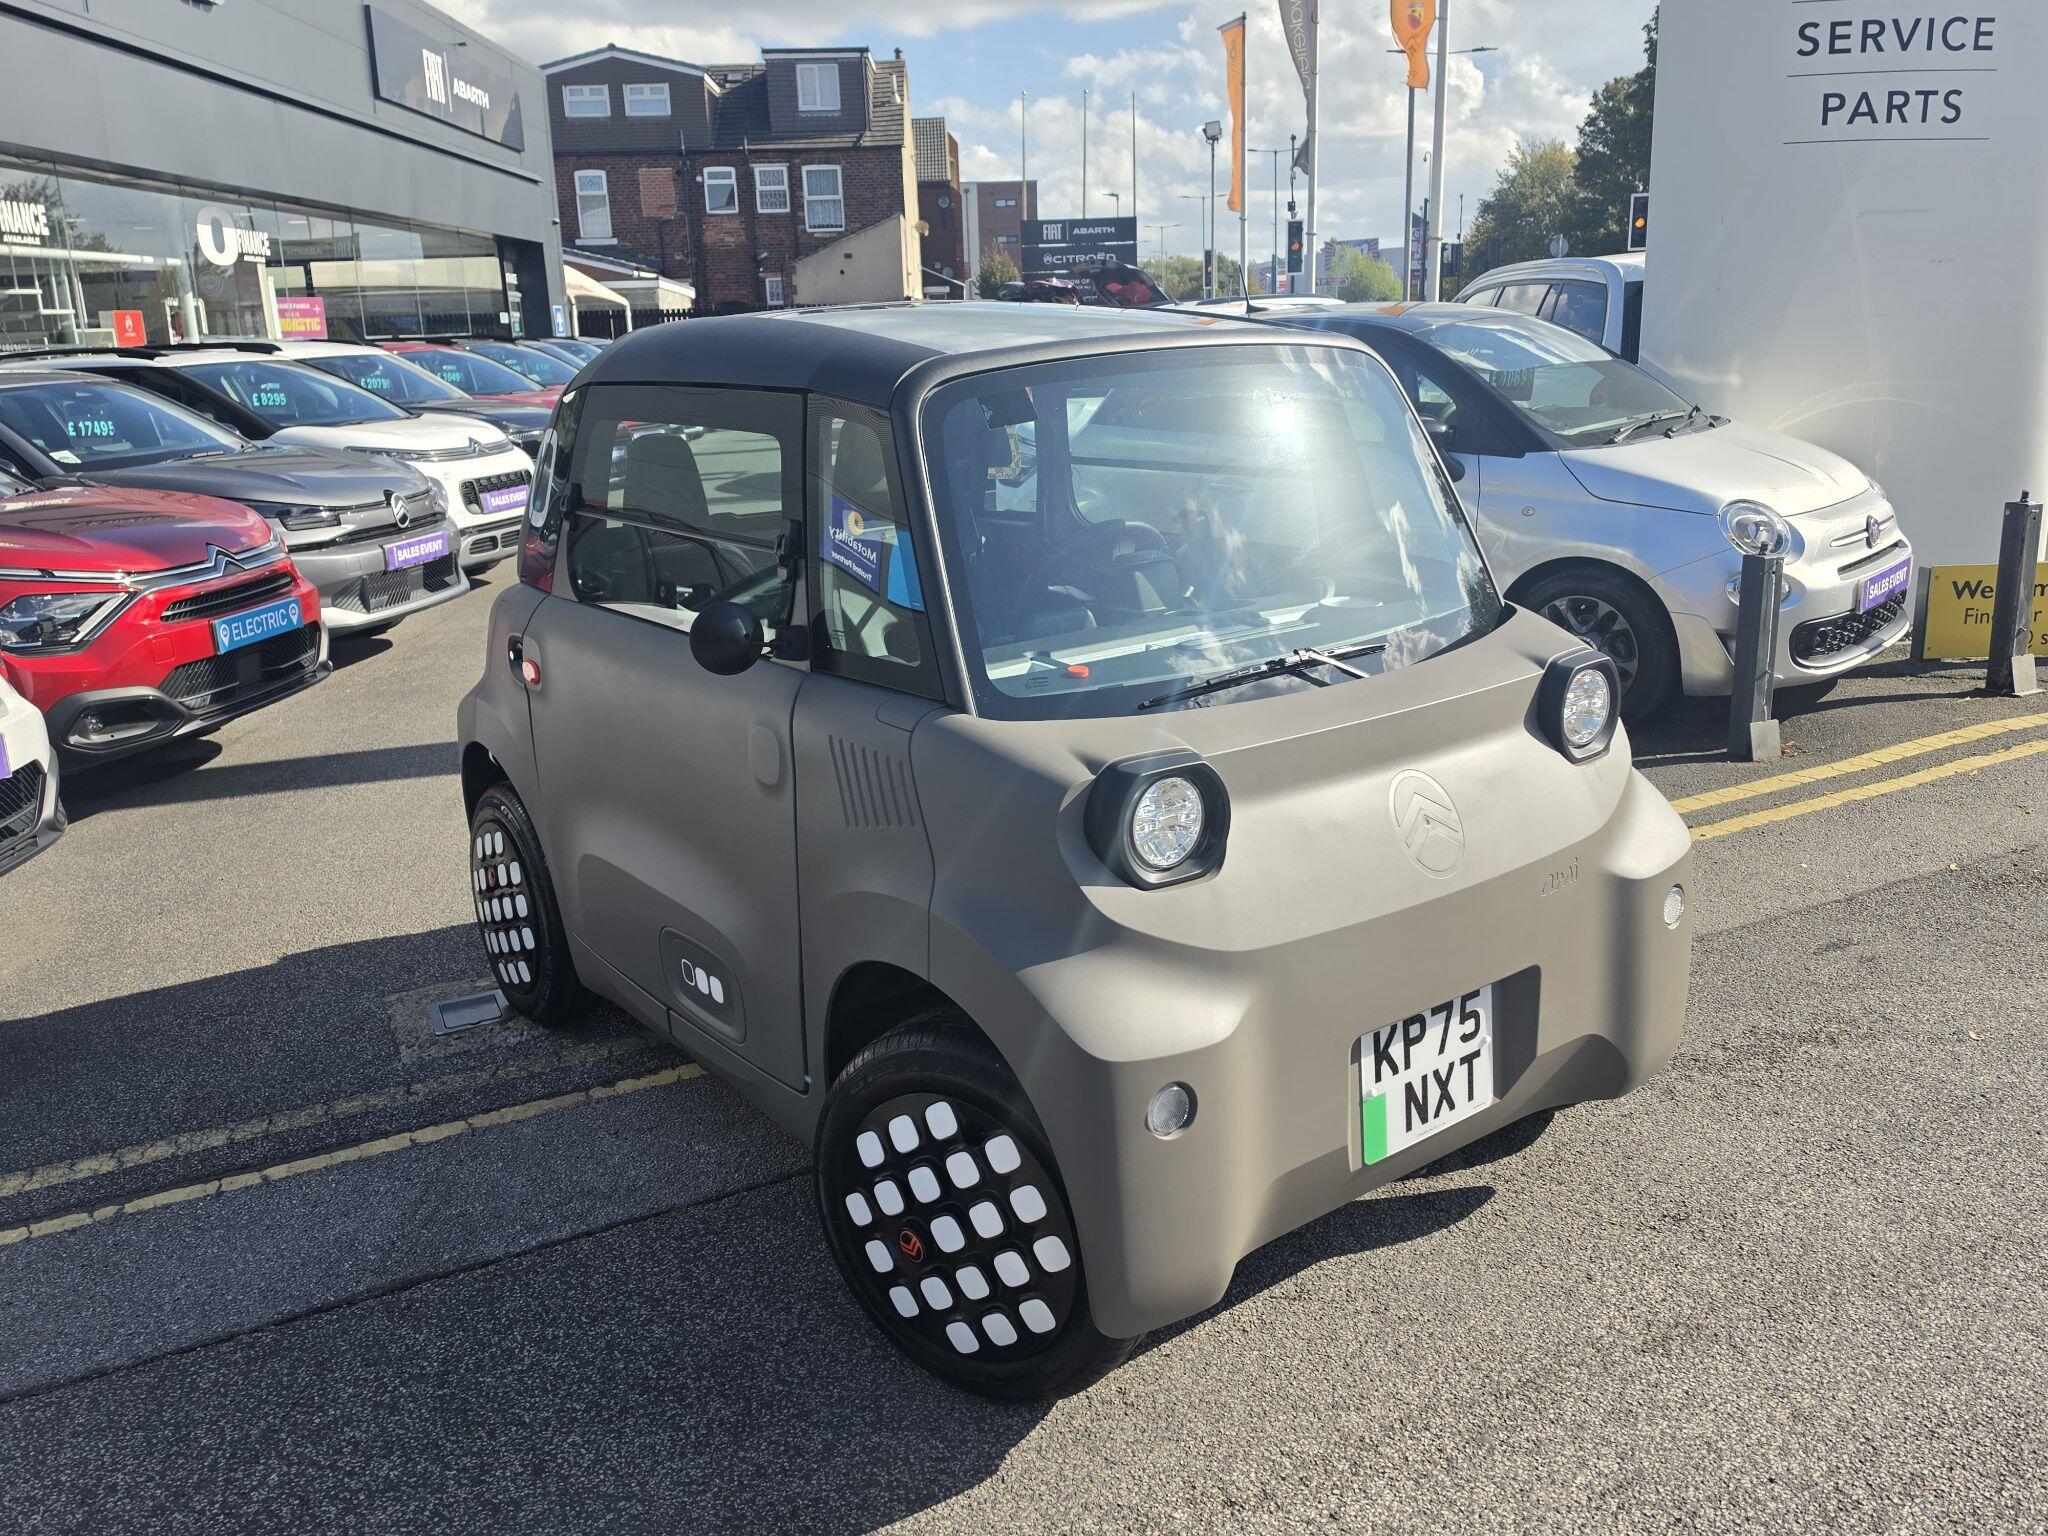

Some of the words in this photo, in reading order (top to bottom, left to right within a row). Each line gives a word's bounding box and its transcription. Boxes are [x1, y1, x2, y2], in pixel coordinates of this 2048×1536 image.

[1796, 16, 1996, 57] SERVICE
[422, 48, 446, 104] FIAT
[453, 78, 490, 109] ABARTH
[1821, 89, 1963, 126] PARTS
[237, 229, 271, 256] FINANCE
[1043, 224, 1062, 241] FIAT
[1073, 227, 1115, 235] ABARTH
[252, 393, 260, 406] £
[261, 392, 287, 406] 8295
[68, 422, 76, 436] £
[79, 421, 115, 437] 17495
[491, 495, 509, 506] SALES
[510, 491, 527, 503] EVENT
[397, 545, 420, 561] SALES
[420, 539, 443, 555] EVENT
[1869, 578, 1889, 600] SALES
[1889, 566, 1907, 589] EVENT
[232, 609, 287, 641] ELECTRIC
[1963, 607, 1994, 625] Fin
[1373, 990, 1481, 1084] KP75
[1405, 1048, 1481, 1133] NXT
